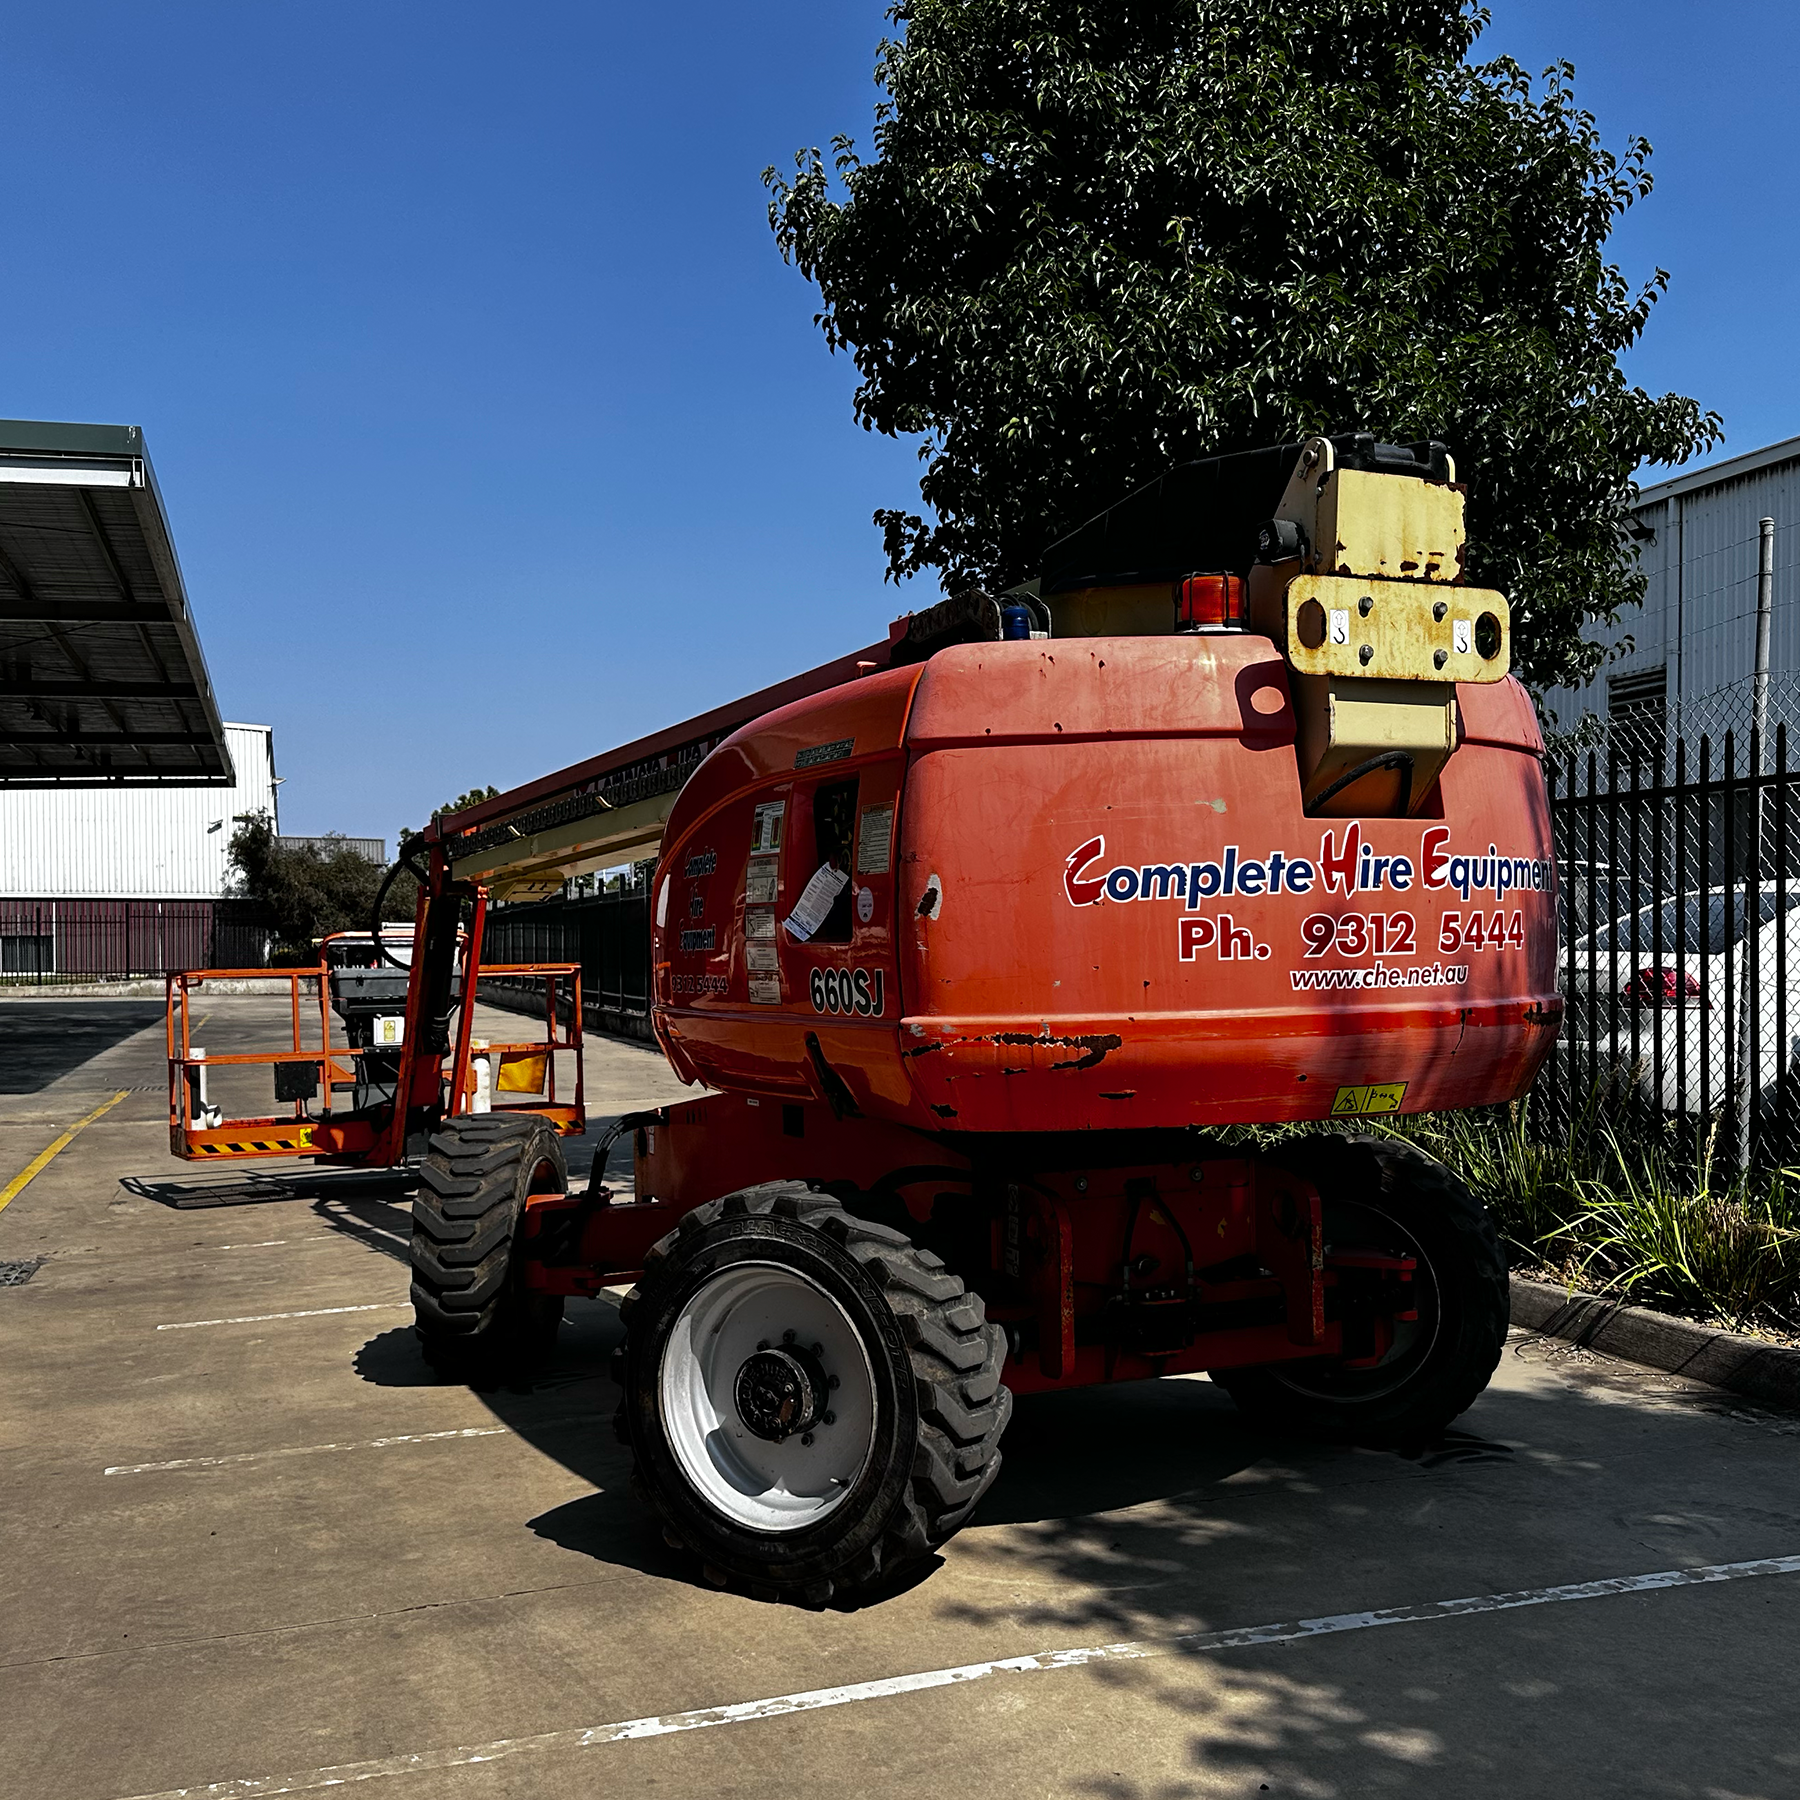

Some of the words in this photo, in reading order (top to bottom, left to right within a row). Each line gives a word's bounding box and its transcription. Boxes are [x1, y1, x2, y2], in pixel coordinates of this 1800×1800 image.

[683, 846, 717, 881] Complete
[1064, 835, 1316, 911] Complete
[1319, 821, 1413, 899] Hire
[1421, 826, 1554, 902] Equipment
[1178, 914, 1271, 961] Ph.
[1301, 911, 1416, 958] 9312
[1438, 910, 1524, 954] 5444
[671, 974, 695, 993] 9312
[696, 976, 729, 994] 5444
[809, 967, 884, 1017] 660SJ
[1290, 961, 1468, 990] www.che.net.au
